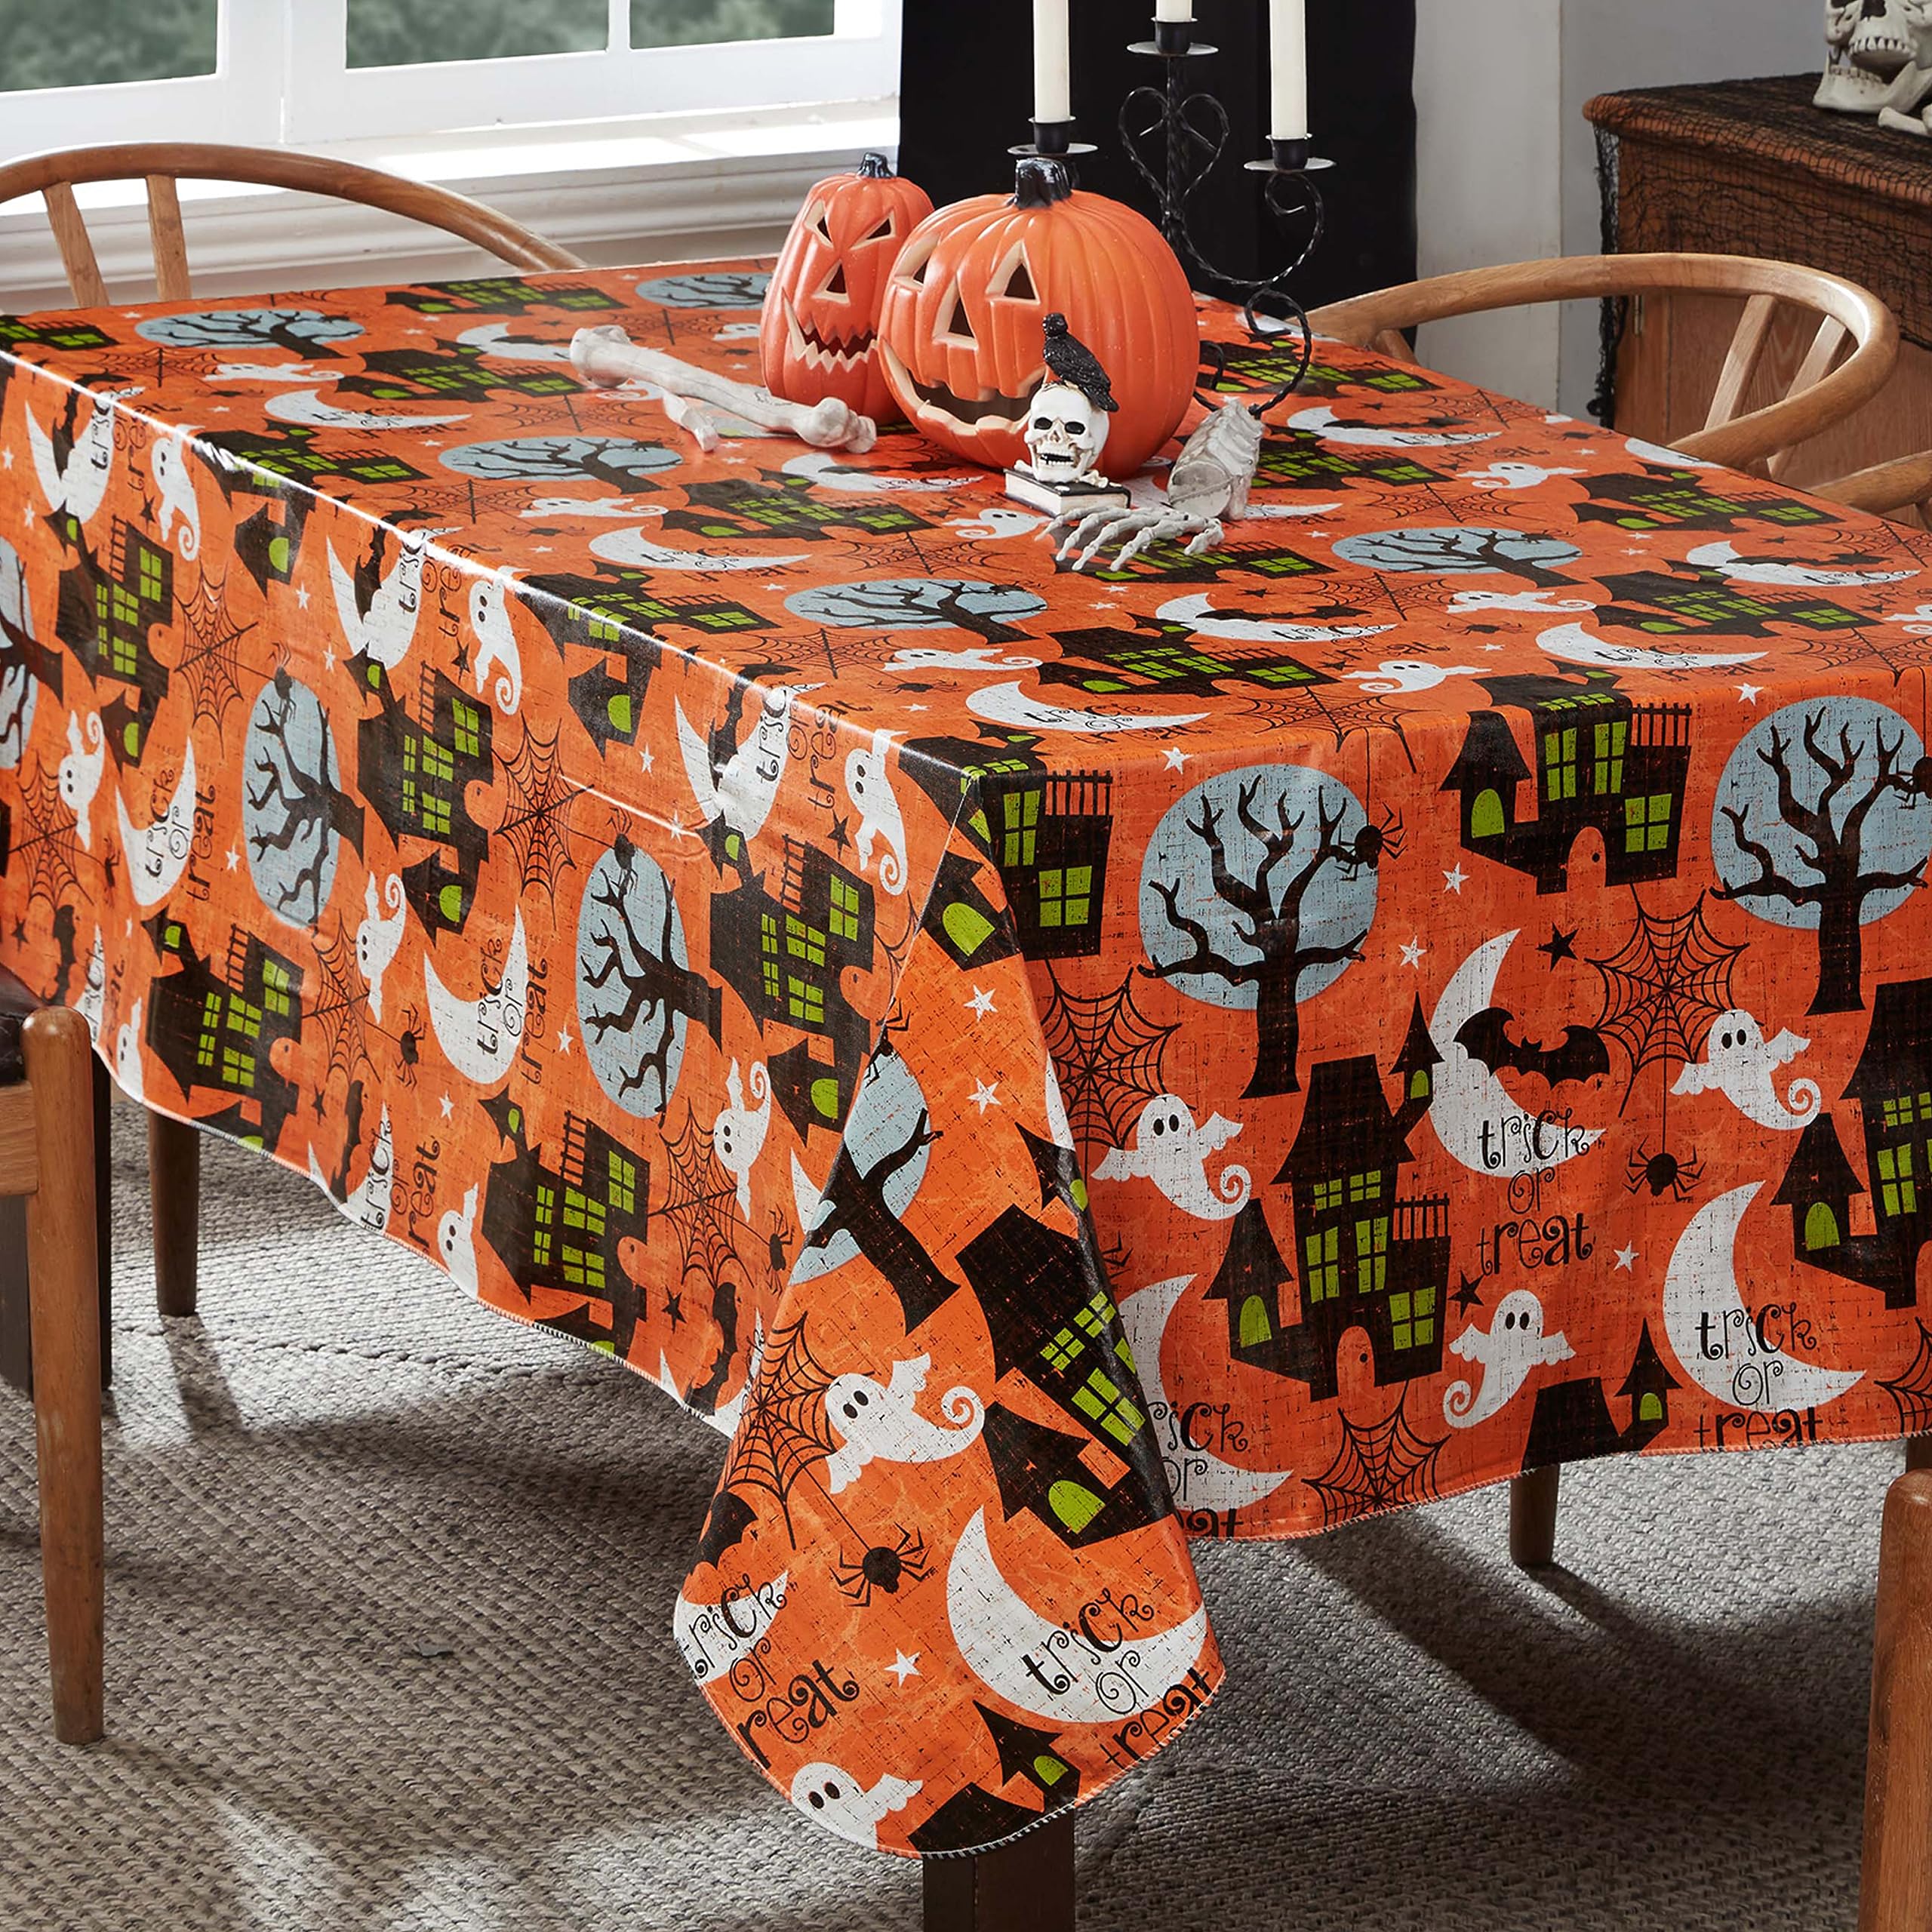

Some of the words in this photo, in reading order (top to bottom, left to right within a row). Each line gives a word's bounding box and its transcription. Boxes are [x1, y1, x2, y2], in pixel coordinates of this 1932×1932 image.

[1272, 623, 1396, 641] trick
[1321, 641, 1451, 661] treat
[1594, 643, 1715, 661] trick
[1647, 662, 1776, 681] treat
[1023, 703, 1154, 723] trick
[1071, 724, 1212, 745] treat
[1084, 716, 1134, 731] or
[145, 768, 175, 878] trick
[169, 805, 190, 860] or
[186, 785, 216, 901] treat
[477, 938, 503, 1055] trick
[503, 978, 523, 1038] or
[521, 958, 548, 1084] treat
[1477, 1107, 1590, 1170] trick
[361, 1120, 393, 1231] trick
[390, 1158, 410, 1216] or
[408, 1140, 441, 1255] reat
[1507, 1167, 1556, 1215] or
[1476, 1212, 1594, 1276] treat
[1694, 1301, 1817, 1361] trick
[1732, 1360, 1785, 1407] or
[729, 1637, 772, 1703] or
[1021, 1587, 1155, 1695] trick
[1095, 1650, 1150, 1715] or
[736, 1659, 860, 1770] reat
